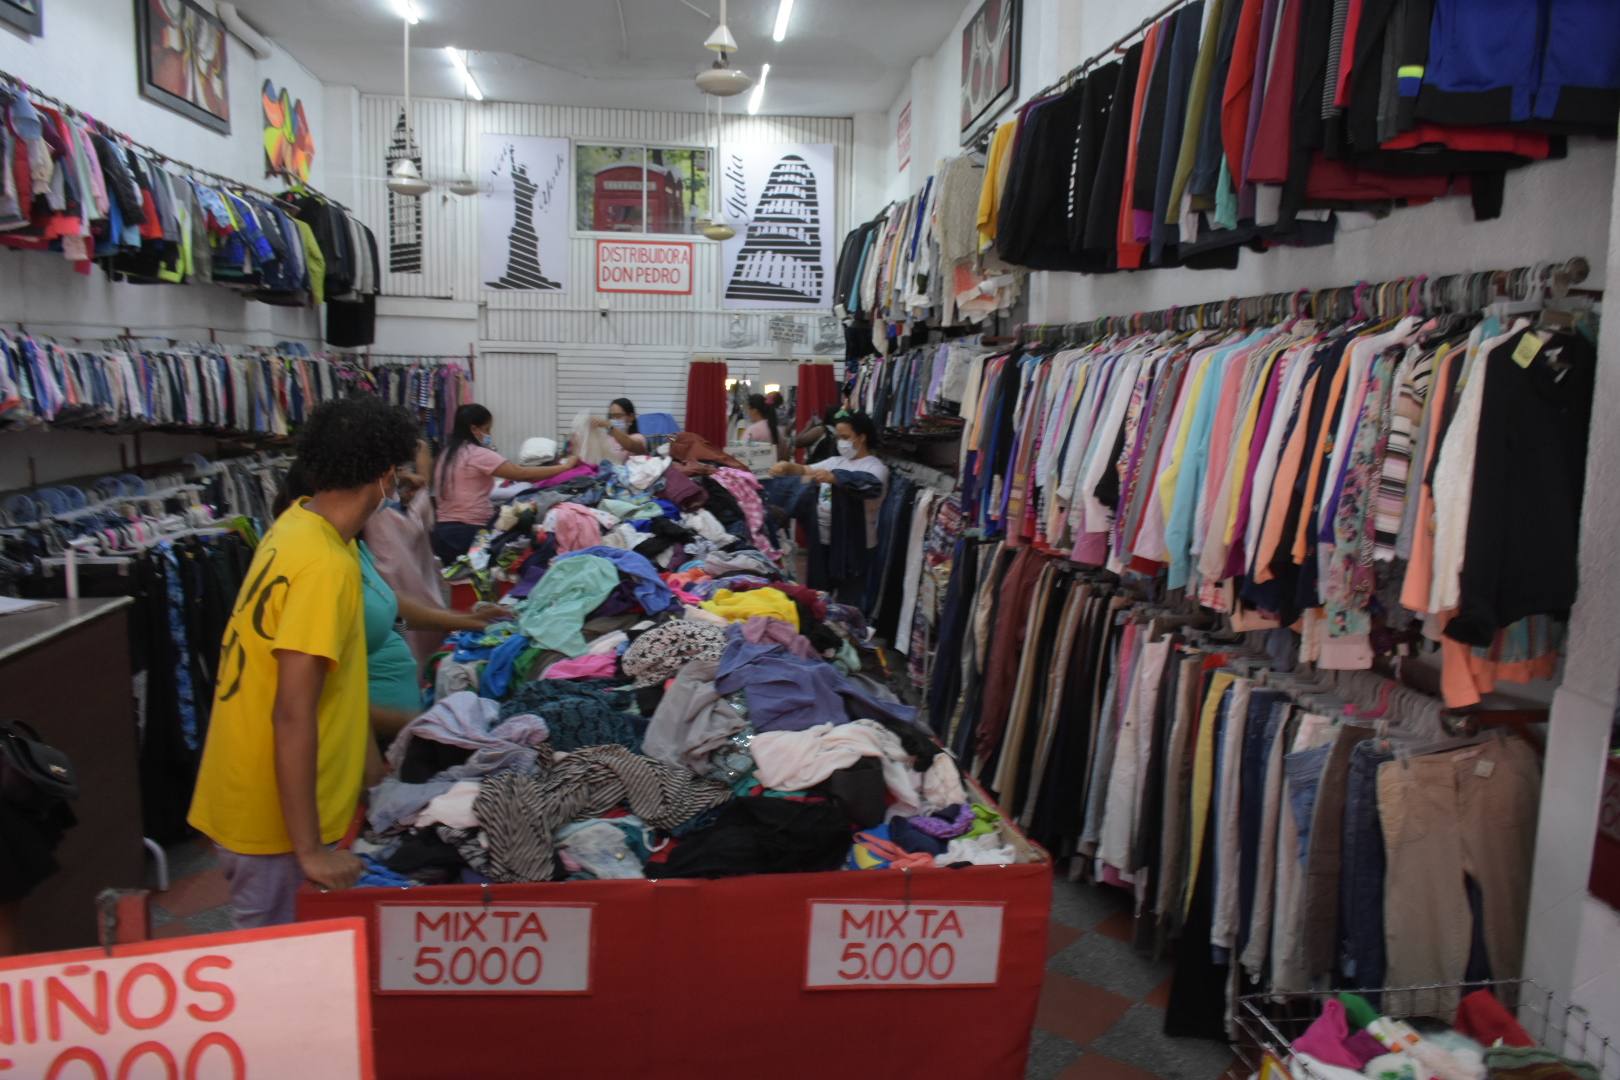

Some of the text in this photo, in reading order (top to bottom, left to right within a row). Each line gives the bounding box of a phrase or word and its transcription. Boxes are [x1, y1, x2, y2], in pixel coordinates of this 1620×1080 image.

[725, 154, 750, 226] Italia
[602, 265, 682, 285] DON PEDRO
[414, 911, 548, 942] MIXTA
[839, 908, 964, 939] MIXTA
[413, 946, 543, 986] 5.000
[837, 942, 955, 981] 5.000
[0, 954, 237, 1046] IÑOS
